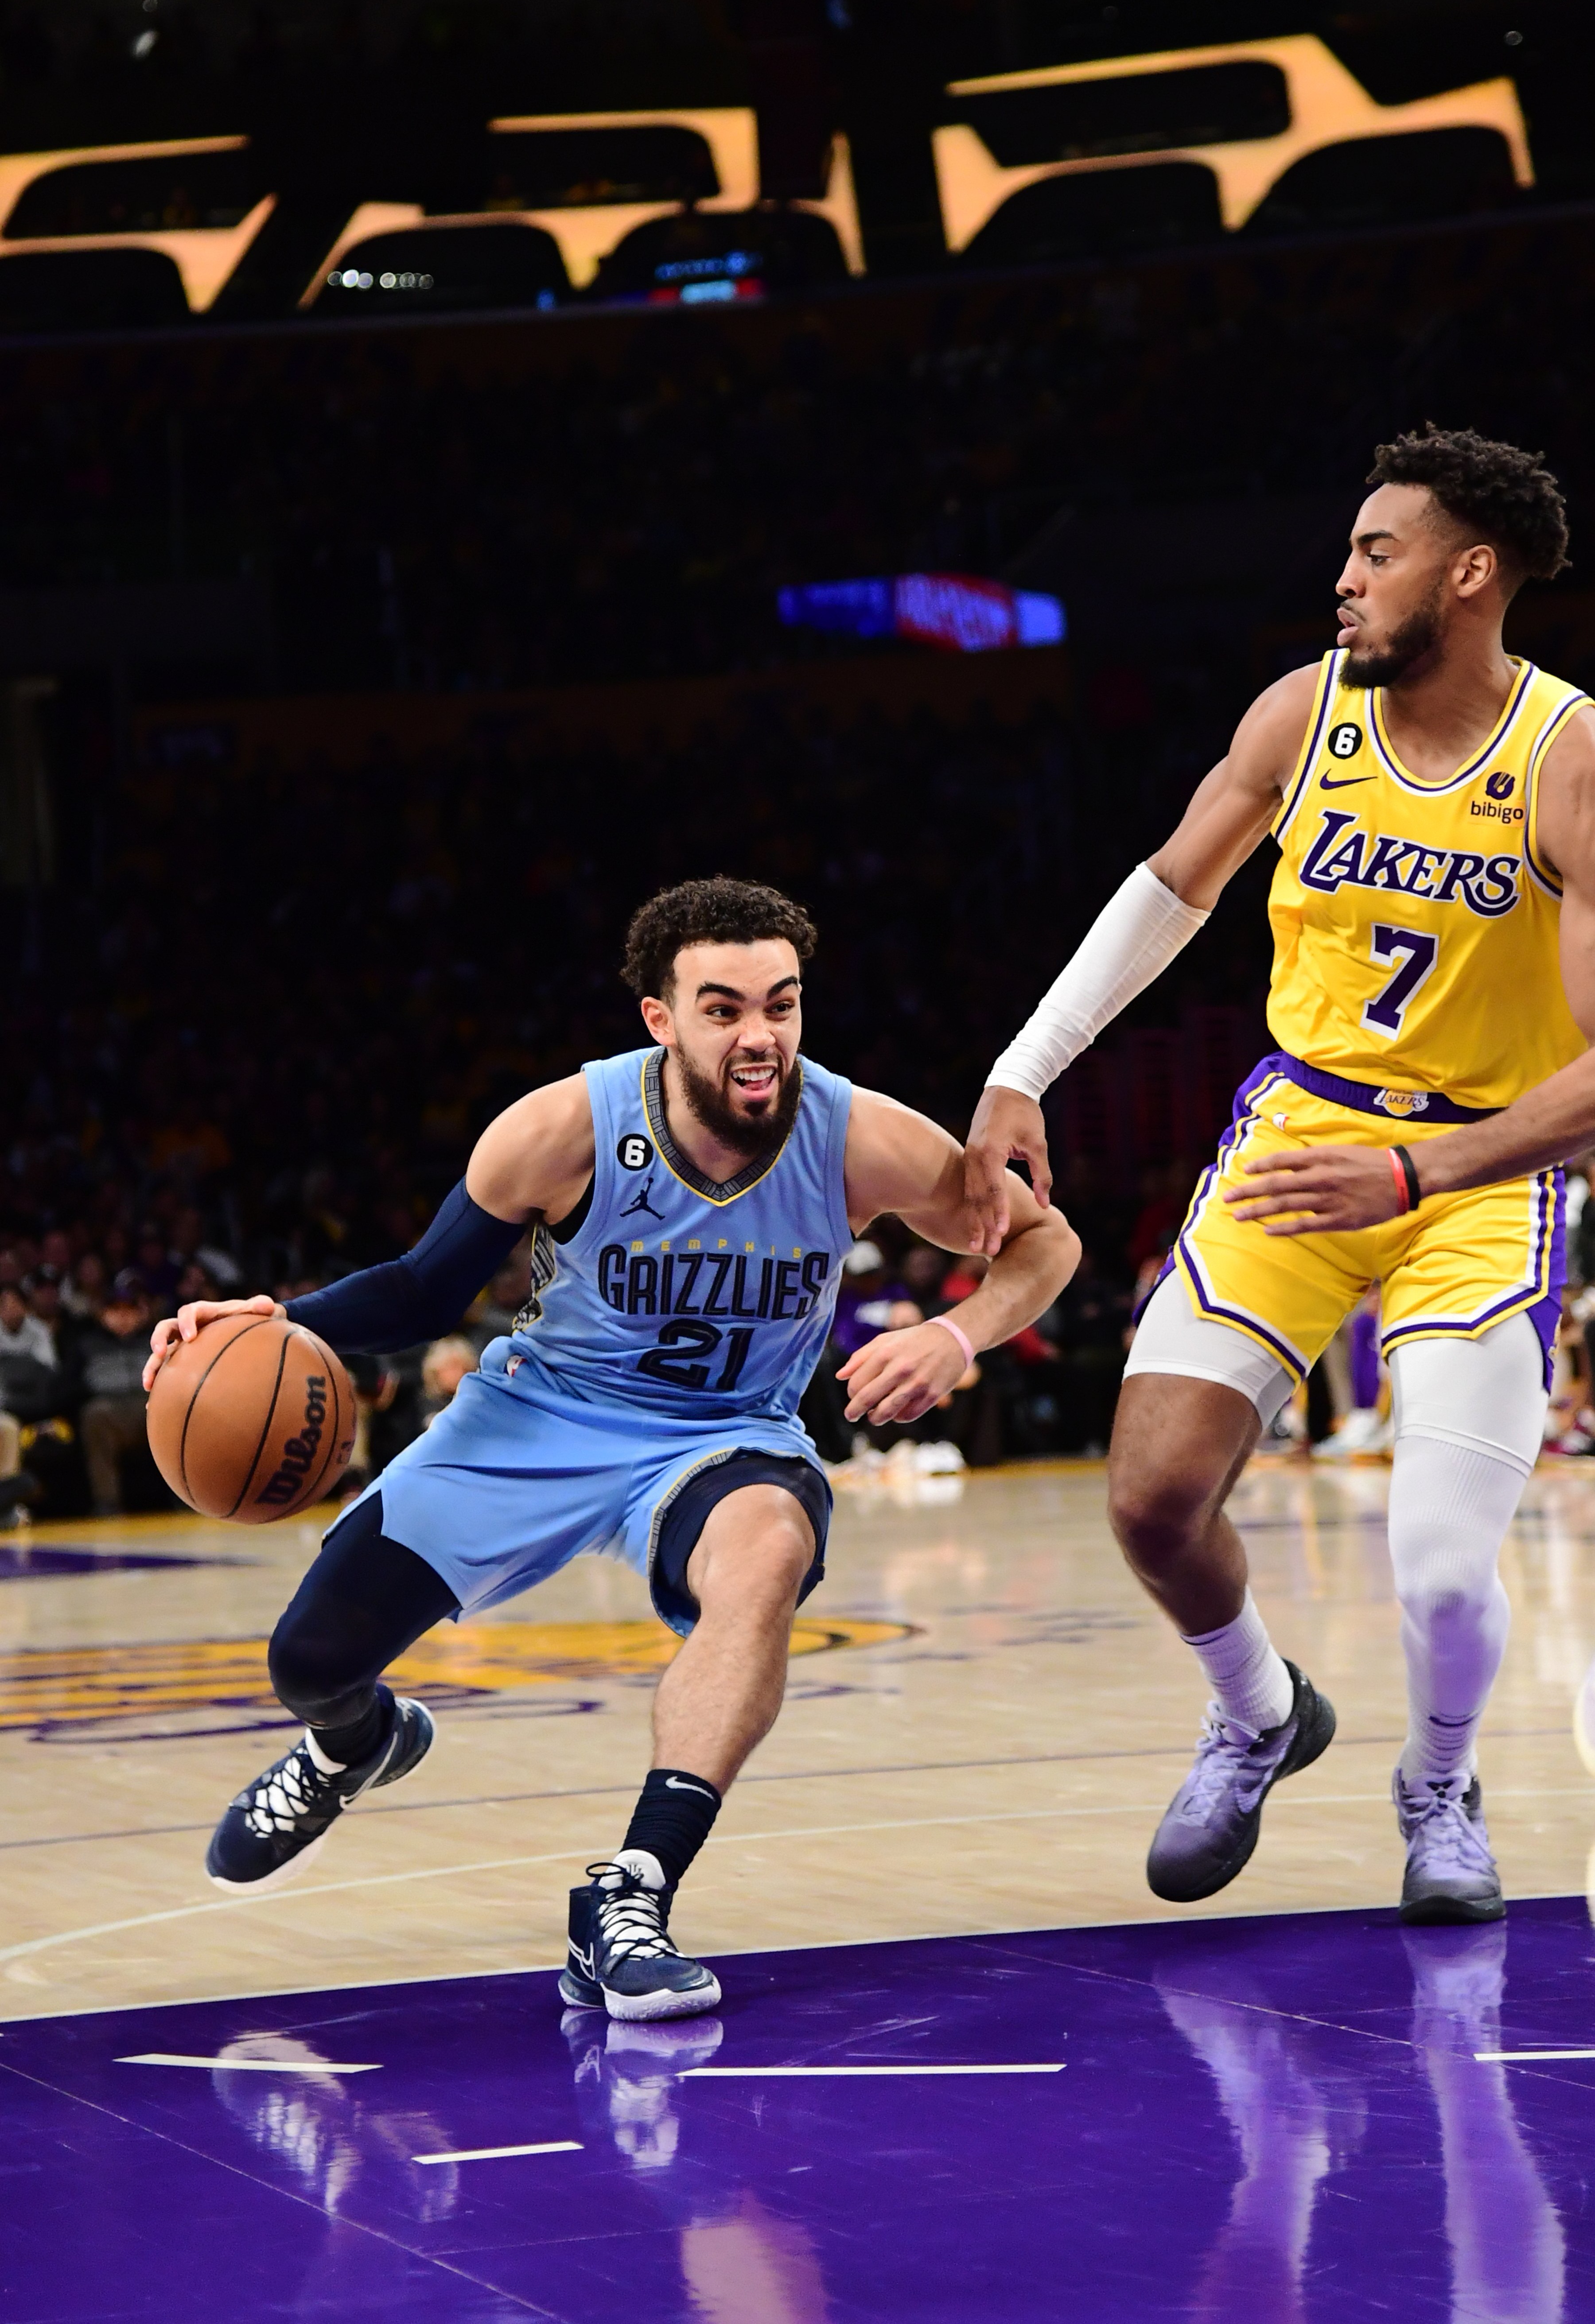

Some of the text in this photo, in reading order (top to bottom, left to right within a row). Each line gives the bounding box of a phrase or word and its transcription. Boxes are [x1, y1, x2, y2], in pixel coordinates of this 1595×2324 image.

[1334, 727, 1357, 756] 6
[1470, 800, 1524, 824] bibigo
[1300, 808, 1523, 918] LAKERS
[1360, 922, 1439, 1041] 7
[624, 1139, 646, 1167] 6
[598, 1244, 829, 1320] GRIZZLIES
[637, 1318, 759, 1392] 21
[255, 1376, 326, 1504] Wilson
